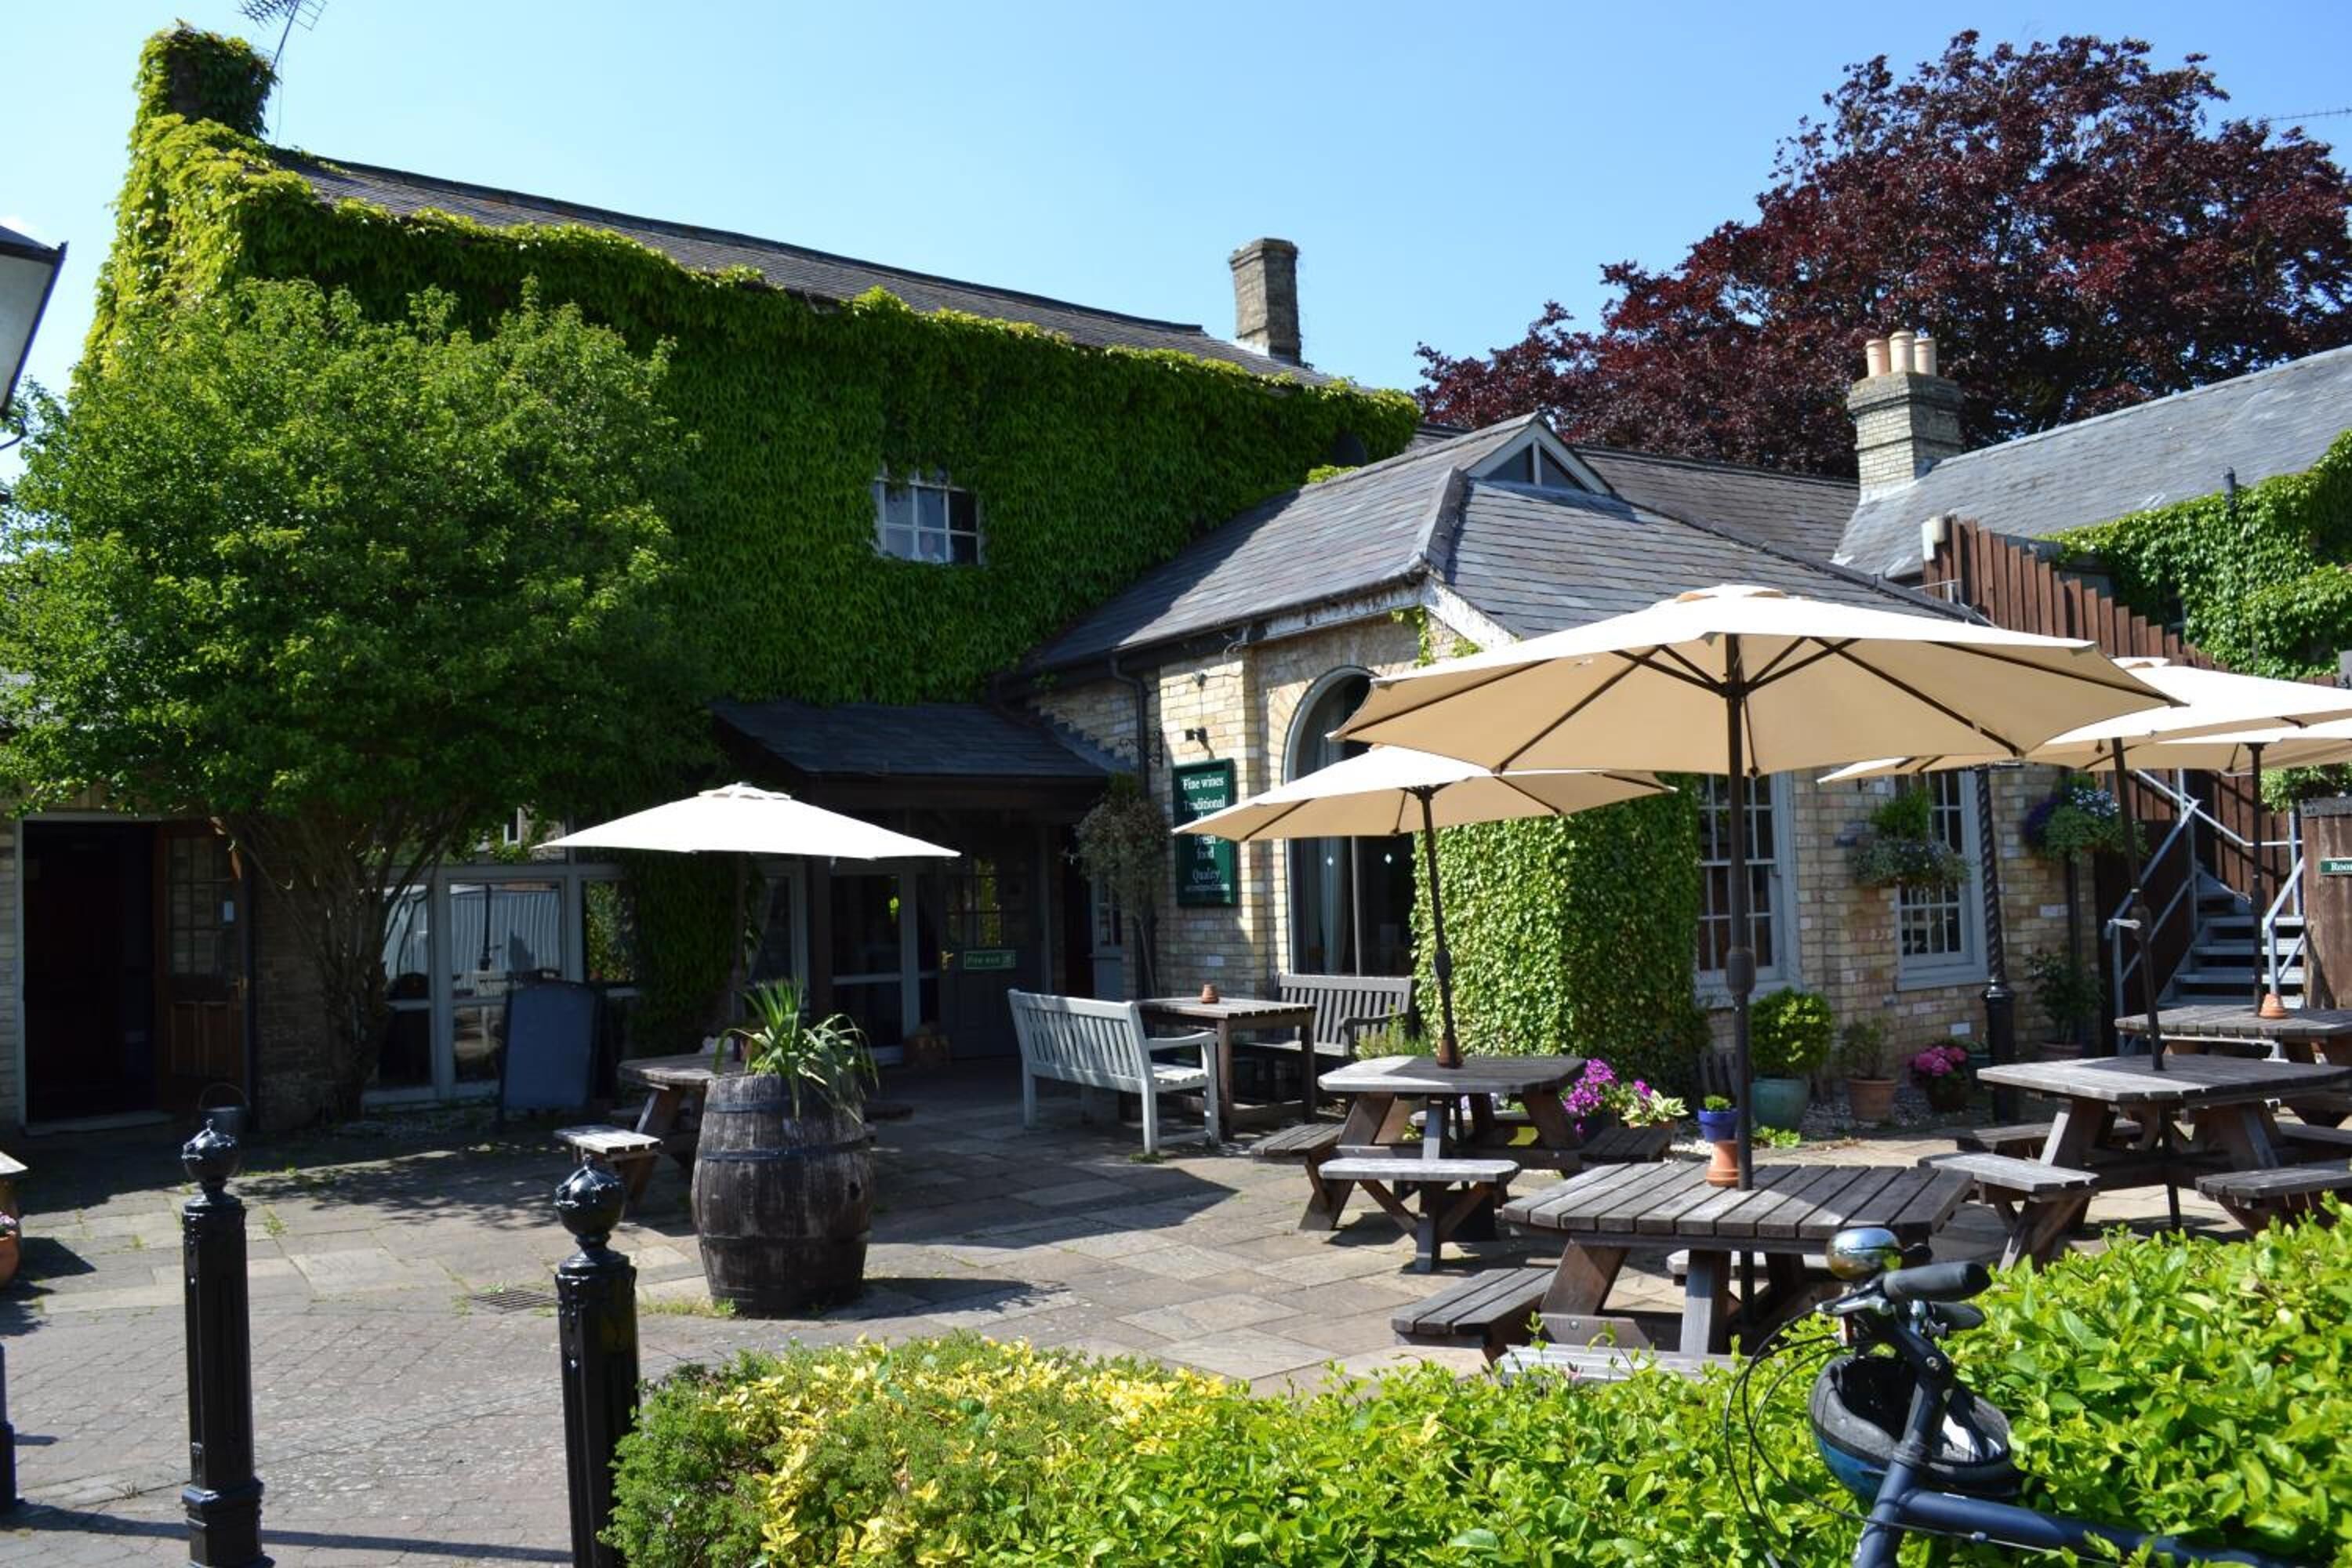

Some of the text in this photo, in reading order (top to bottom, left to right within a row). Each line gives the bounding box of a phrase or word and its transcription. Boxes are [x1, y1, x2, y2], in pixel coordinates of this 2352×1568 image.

[1182, 775, 1224, 790] Fine wines
[1184, 794, 1225, 811] Traditional
